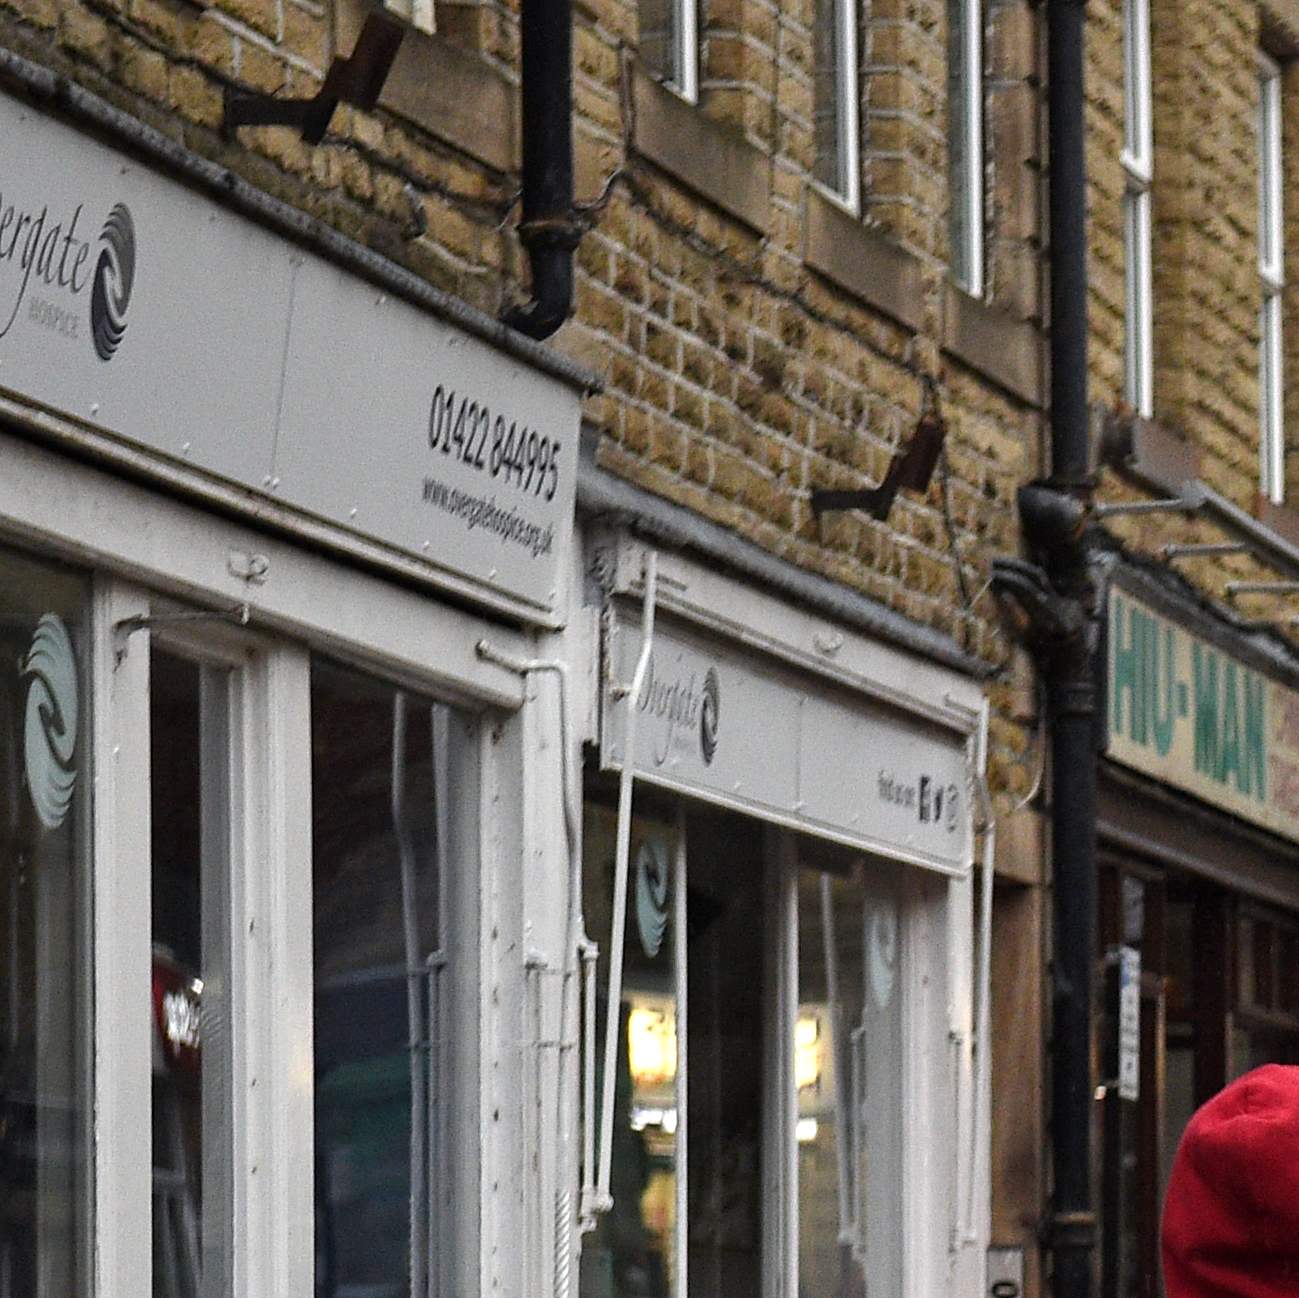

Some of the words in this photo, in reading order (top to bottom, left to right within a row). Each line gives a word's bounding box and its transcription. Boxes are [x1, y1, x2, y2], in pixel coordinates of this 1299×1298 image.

[0, 200, 92, 338] ergate
[429, 384, 490, 470] 01422
[490, 414, 561, 503] 844995
